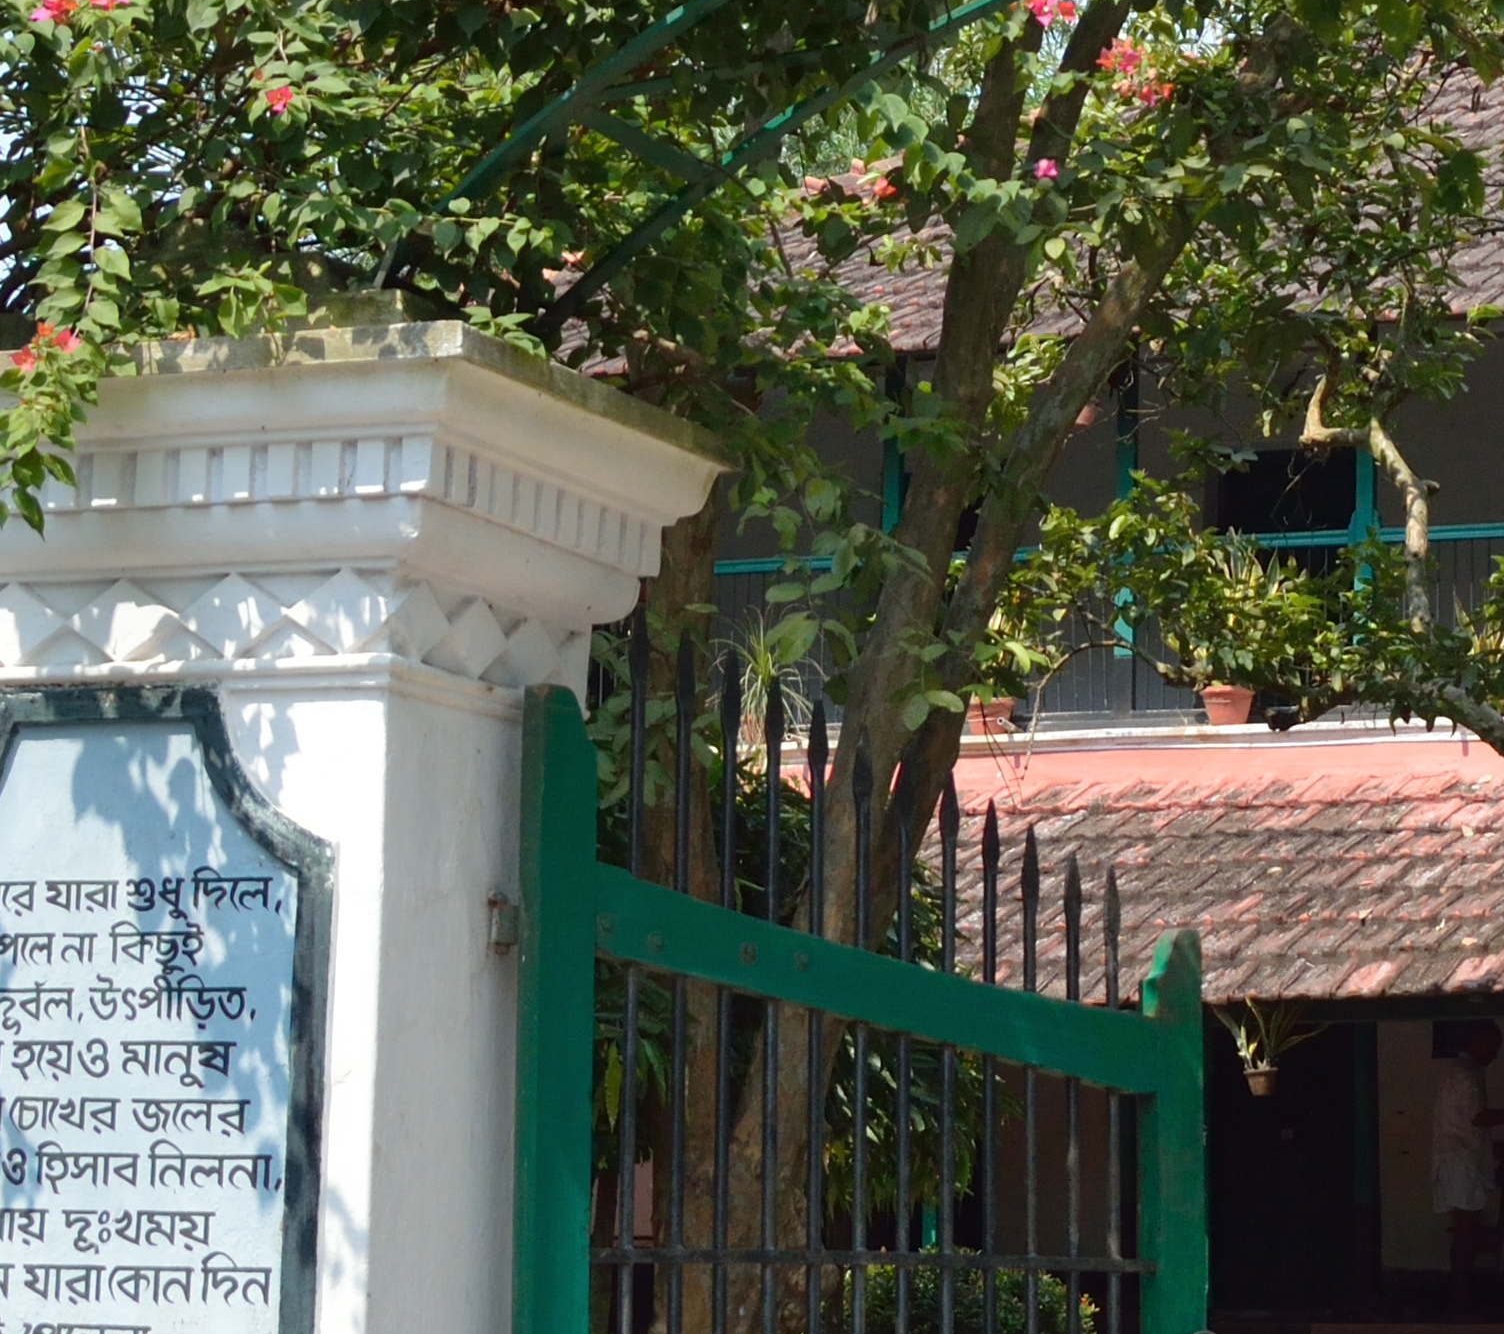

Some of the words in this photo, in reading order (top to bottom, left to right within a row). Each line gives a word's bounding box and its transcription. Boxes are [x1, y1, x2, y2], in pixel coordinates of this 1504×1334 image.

[44, 879, 120, 914] যারা
[125, 876, 189, 920] শুধু
[60, 932, 99, 965] না
[110, 921, 205, 977] কিছুই
[119, 1039, 238, 1089] মানুষ
[4, 1095, 122, 1135] চোখের
[130, 1097, 252, 1138] জলের
[33, 1139, 141, 1195] হিসাব
[22, 1263, 108, 1306] যারা
